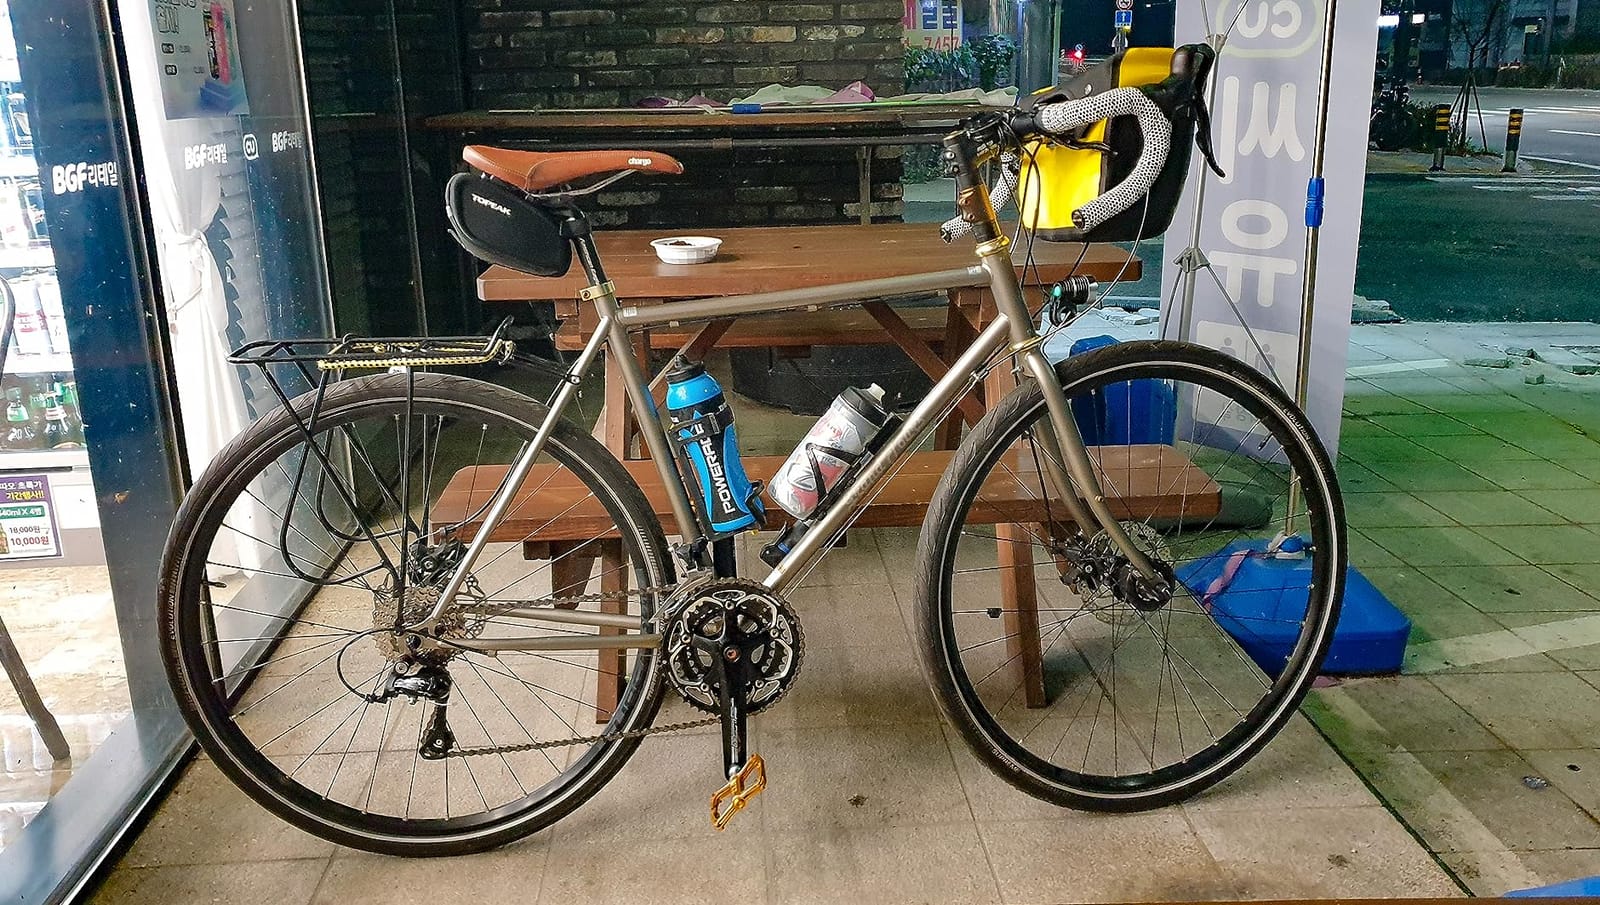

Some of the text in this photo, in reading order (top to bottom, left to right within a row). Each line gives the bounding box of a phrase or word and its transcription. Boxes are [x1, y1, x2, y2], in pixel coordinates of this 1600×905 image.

[184, 143, 228, 170] BGF리테일
[52, 161, 118, 195] BGF리테일
[471, 193, 512, 217] TOPEAK
[10, 536, 49, 546] 10,000원
